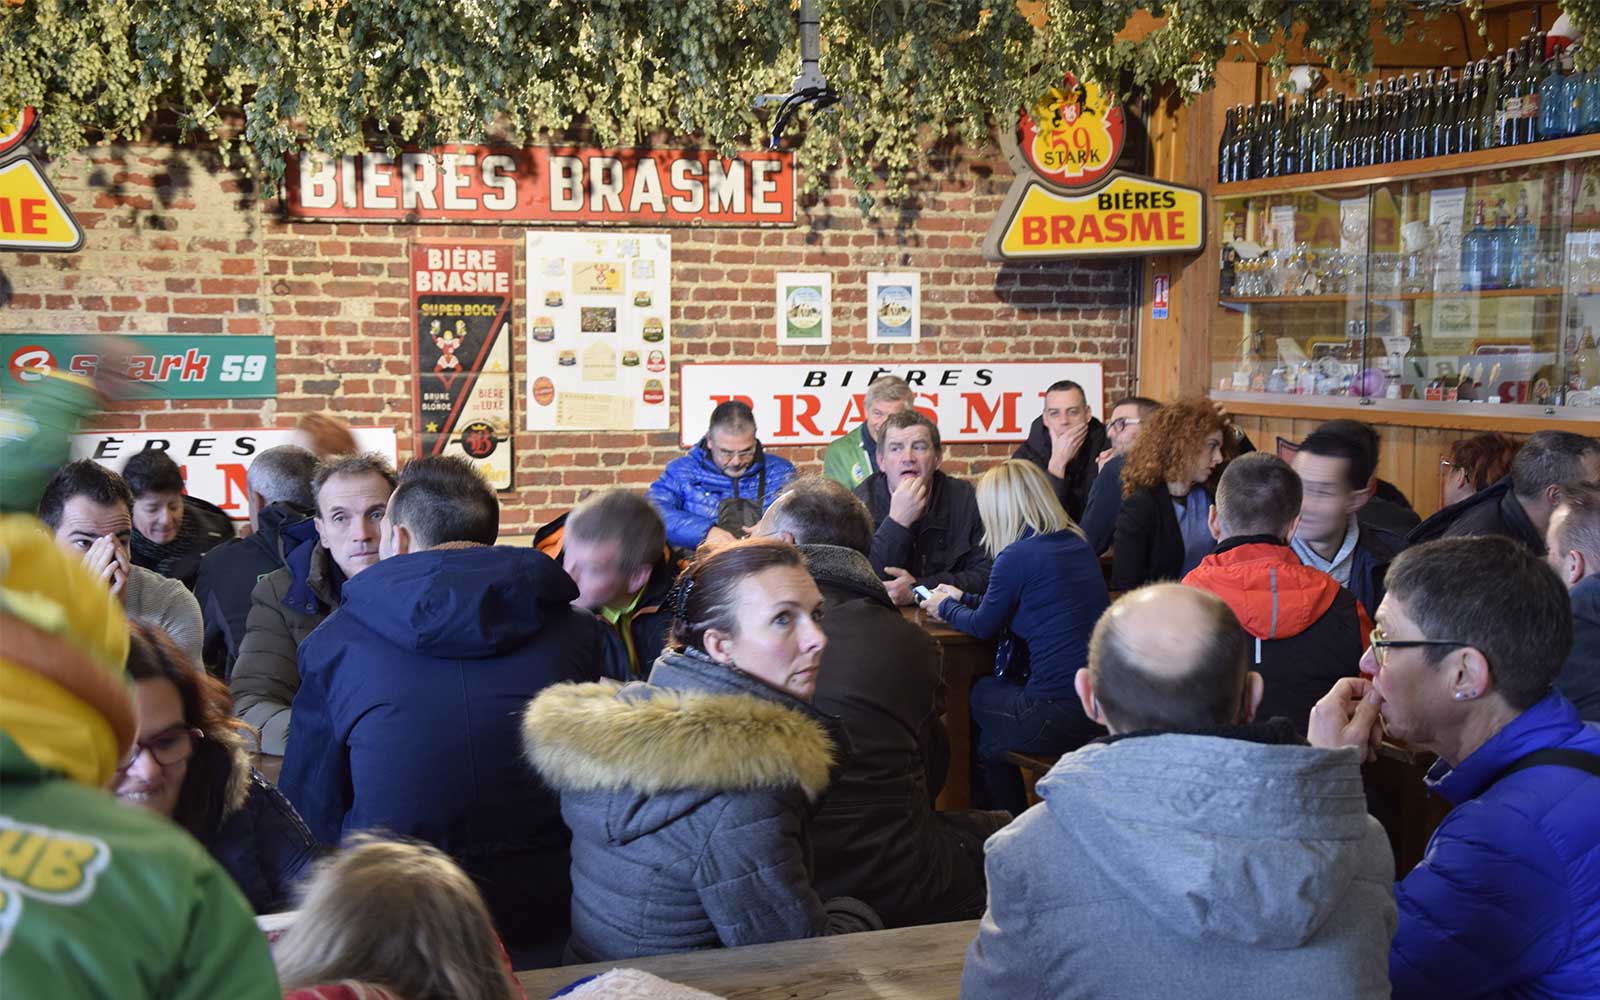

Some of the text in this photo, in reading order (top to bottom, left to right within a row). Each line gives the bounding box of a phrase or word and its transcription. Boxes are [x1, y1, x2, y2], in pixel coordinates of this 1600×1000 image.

[1044, 149, 1101, 166] STARK
[1051, 127, 1091, 167] 59
[548, 154, 783, 214] BRASME
[1098, 189, 1176, 211] BIÈRES
[1022, 211, 1185, 246] BRASME
[427, 247, 496, 271] BIÈRE
[416, 271, 509, 294] BRASME
[421, 303, 497, 317] SUPER BOCK
[69, 348, 211, 382] sark
[219, 355, 267, 382] 59
[422, 403, 451, 411] BLONDE
[423, 392, 450, 401] BRUNE
[481, 400, 504, 410] LUXE
[709, 392, 1047, 437] RASM
[93, 437, 256, 459] ÈRES
